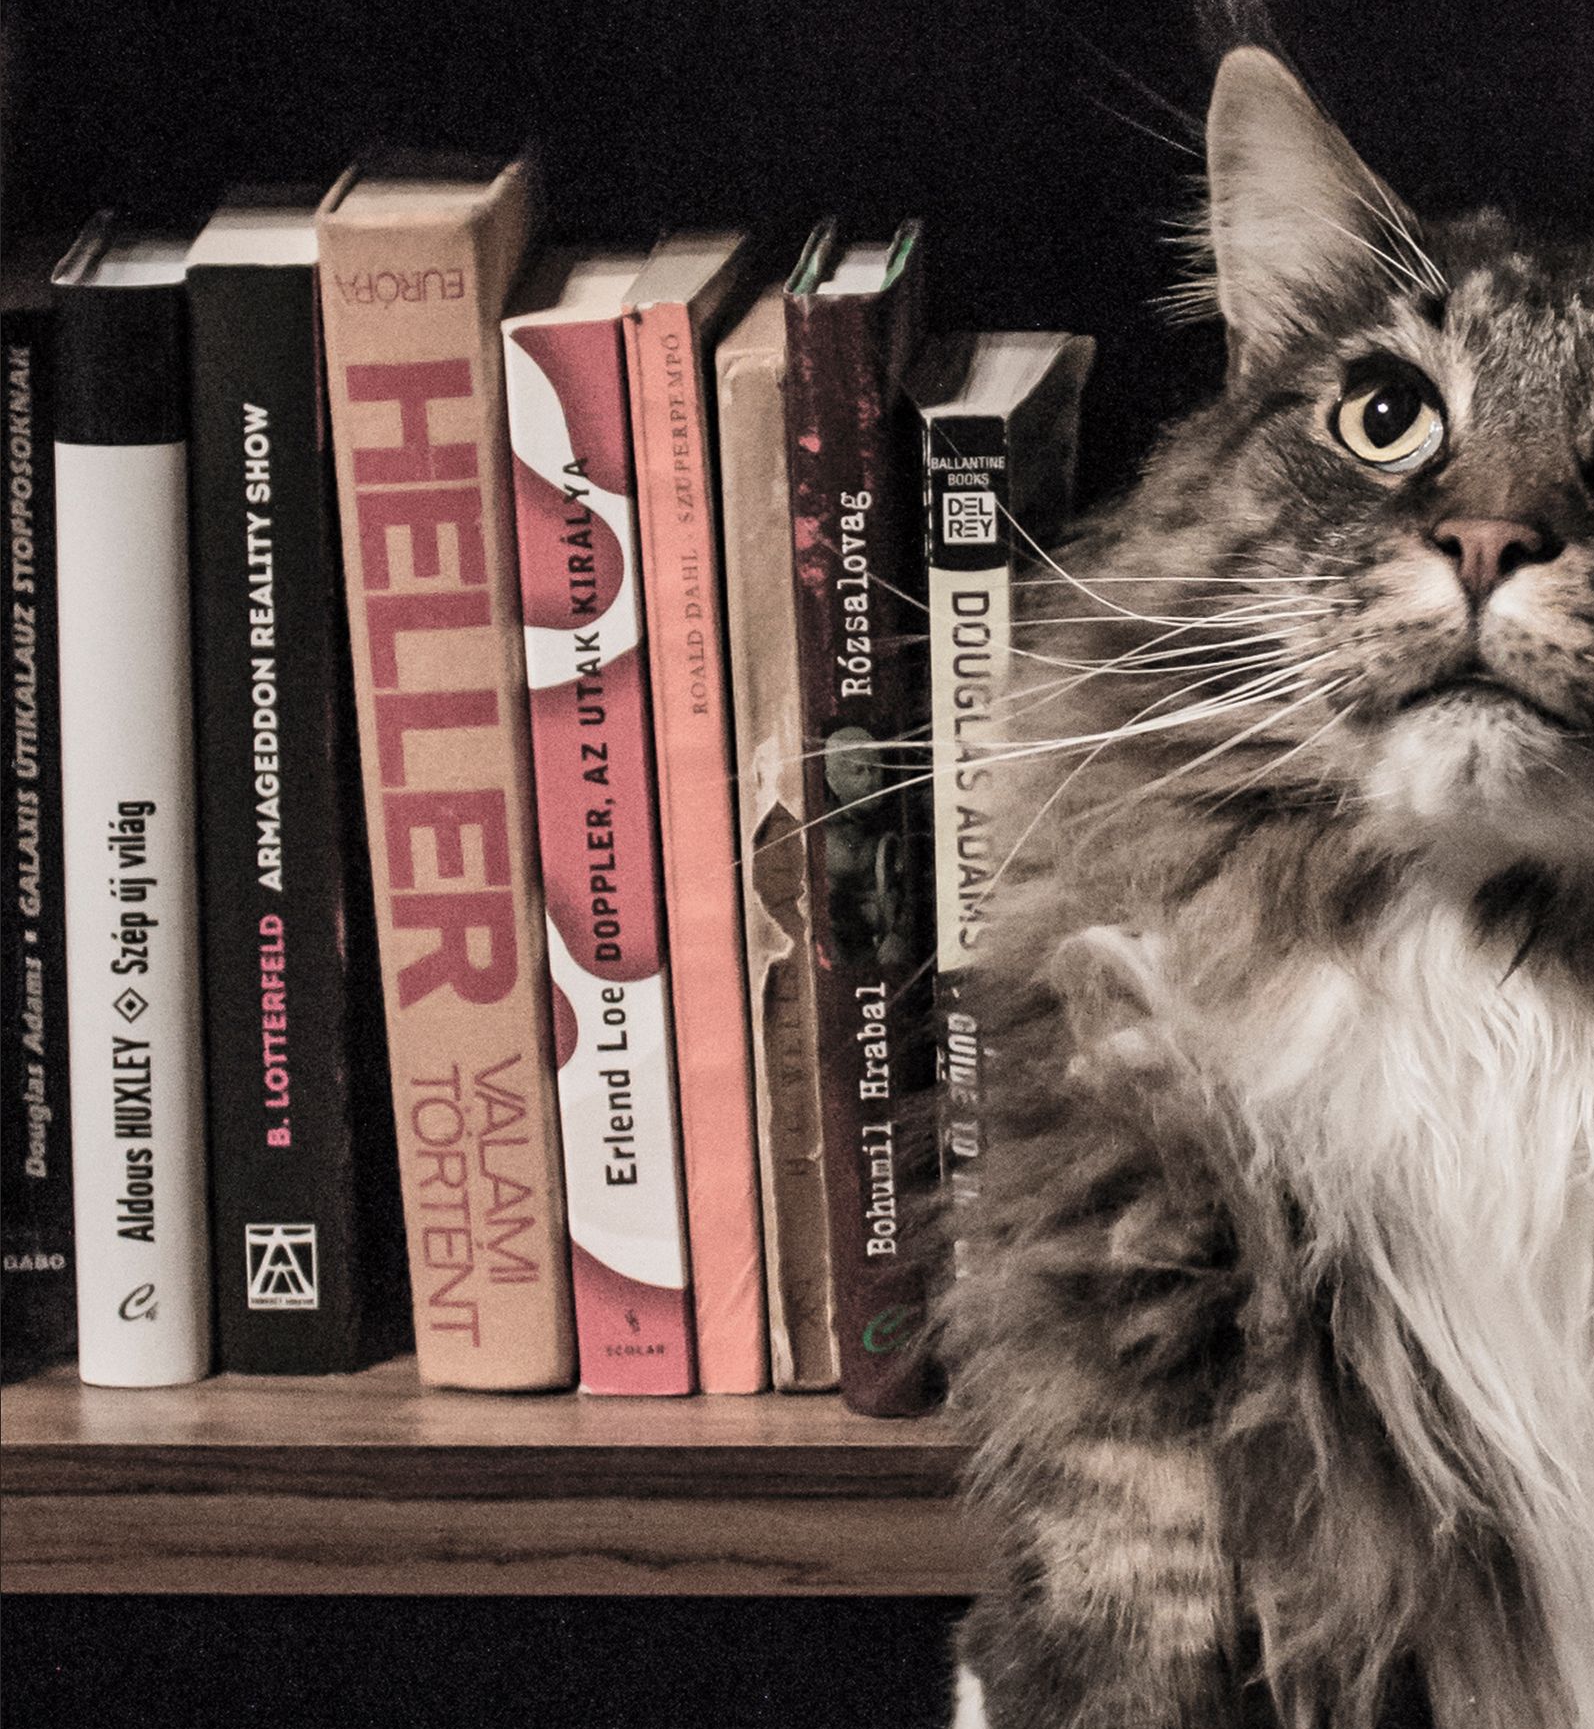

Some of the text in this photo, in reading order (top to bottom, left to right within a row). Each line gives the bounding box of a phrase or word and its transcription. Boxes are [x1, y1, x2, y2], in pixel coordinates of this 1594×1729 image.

[10, 343, 45, 1054] Adams GALAXIS ÚTIKALAUZ STOPPOSOKNAK
[345, 358, 518, 1012] HELLER
[930, 456, 1007, 486] BALLANTINE BOOKS
[951, 590, 991, 791] DOUGLAS
[107, 800, 159, 1242] Aldous HUXLEY Szép világ
[241, 401, 290, 1110] LOTTERFELD ARMAGEDDON REALITY SHOW
[562, 457, 639, 1188] Erlend Loe DOPPLER, UTAK KIRÁLYA
[838, 491, 898, 1257] Bohumil Hrabal Rózsalovag
[405, 1064, 481, 1350] TÖRTÉNT
[474, 1052, 540, 1285] VALAMI
